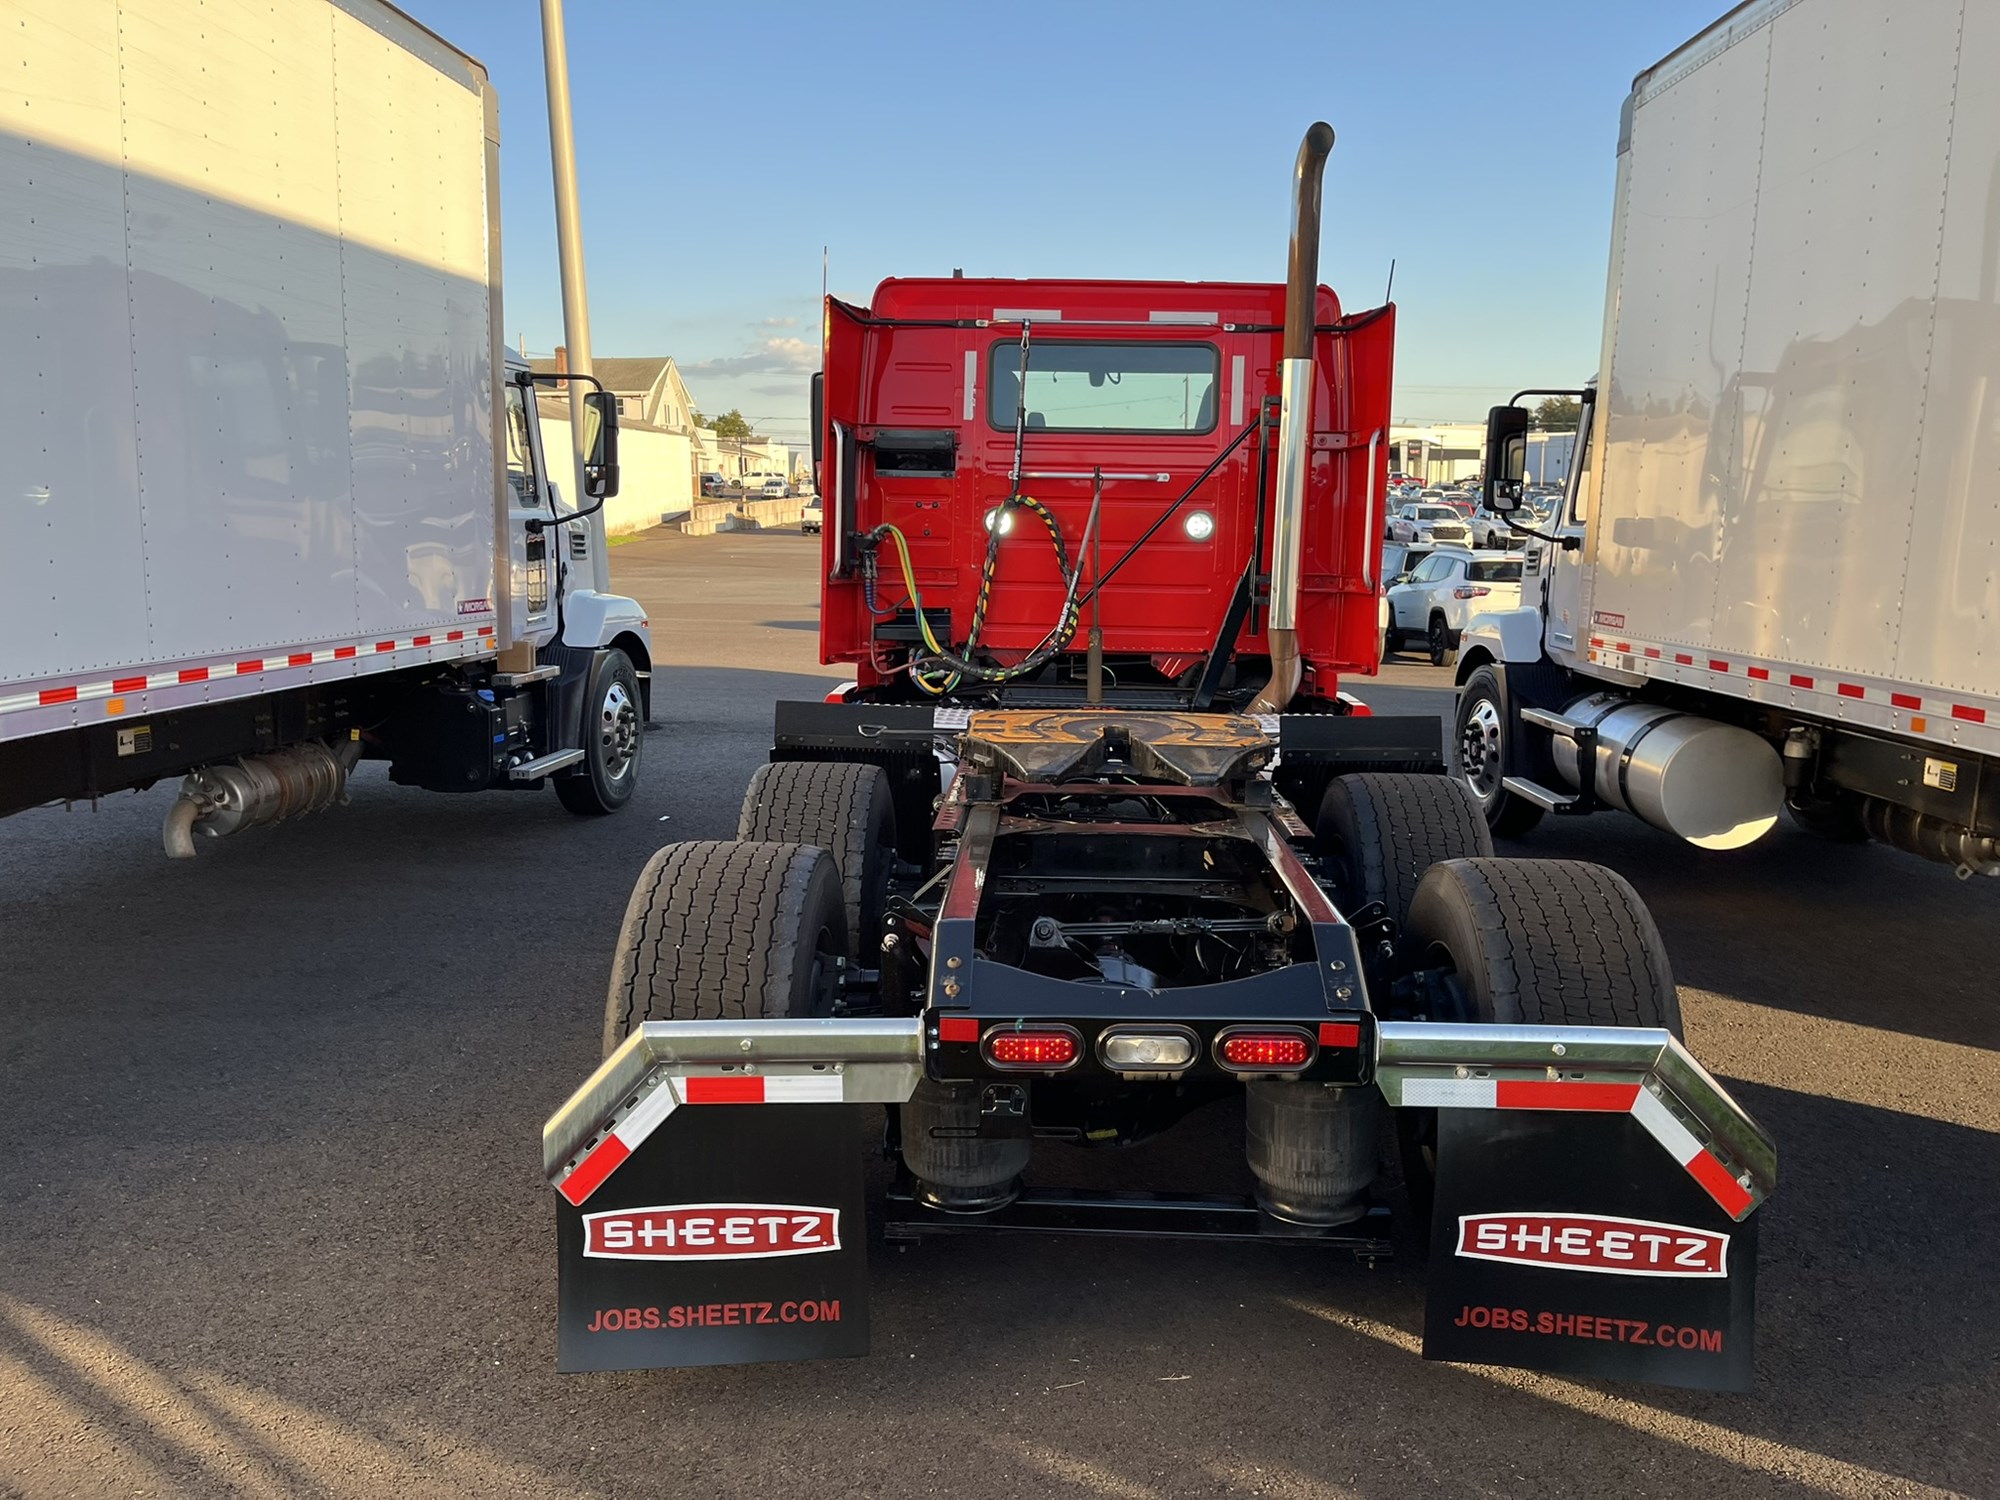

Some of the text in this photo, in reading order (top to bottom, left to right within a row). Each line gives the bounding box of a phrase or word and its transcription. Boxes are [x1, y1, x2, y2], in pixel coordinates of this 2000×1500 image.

[1056, 601, 1071, 633] PHILLIPS
[587, 1300, 841, 1332] JOBS.SHEETZ.COM
[1453, 1305, 1723, 1353] JOBS.SHEETZ.COM
